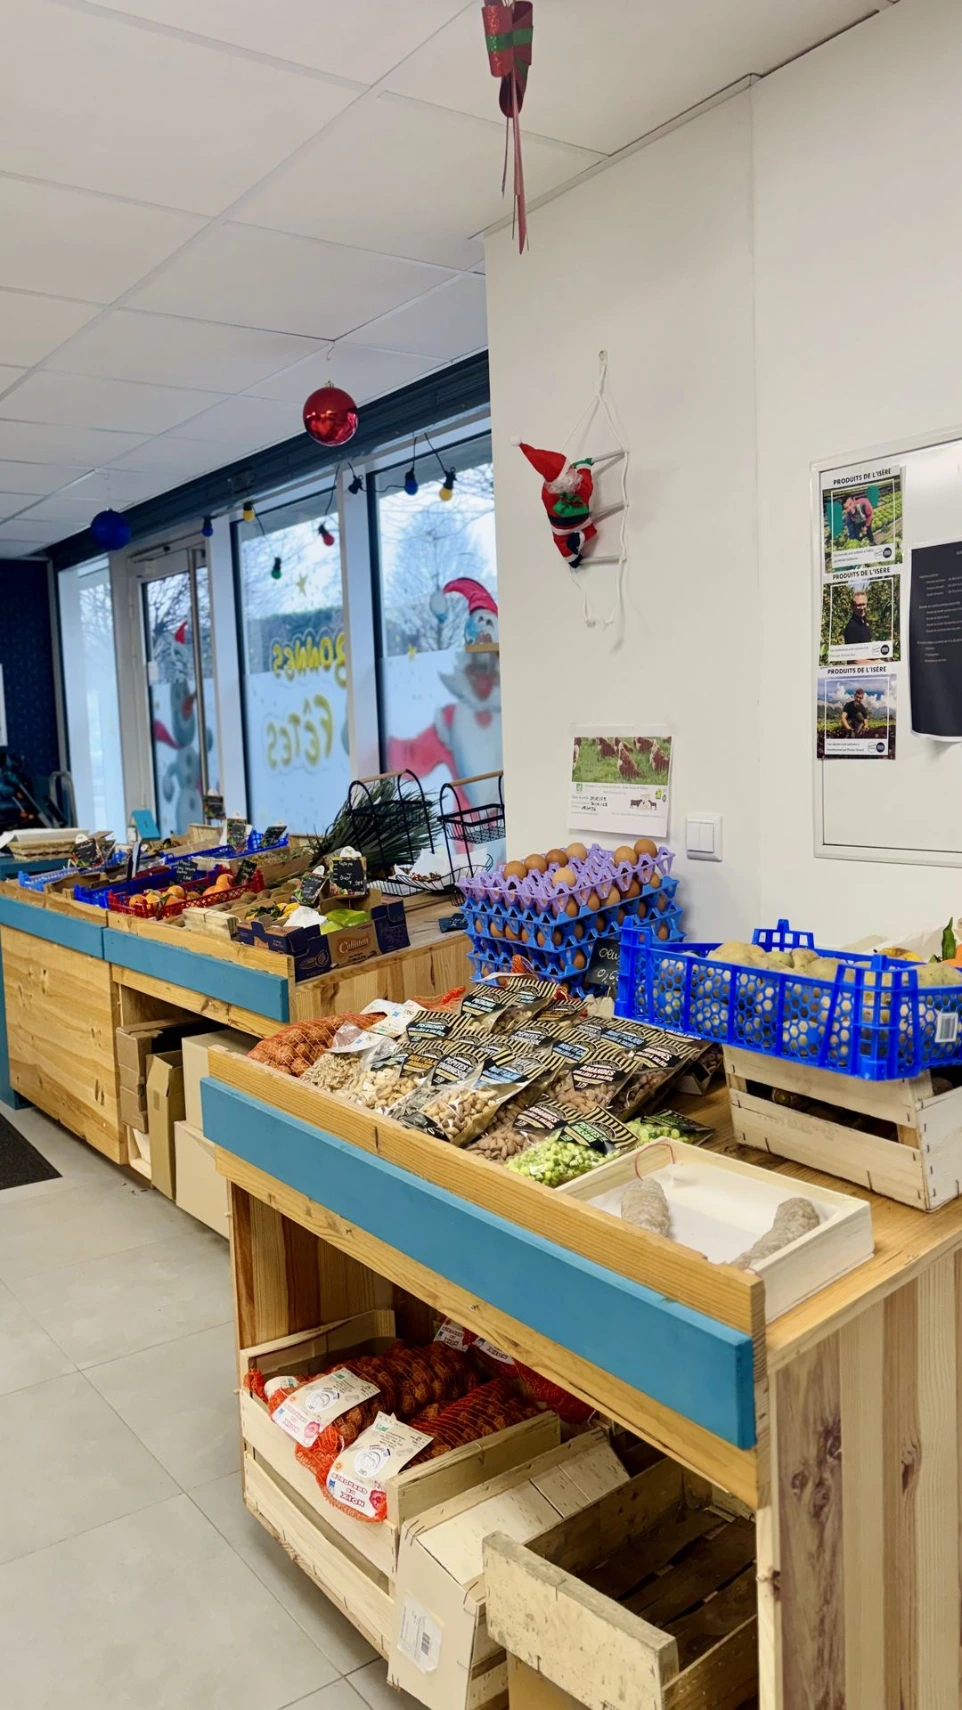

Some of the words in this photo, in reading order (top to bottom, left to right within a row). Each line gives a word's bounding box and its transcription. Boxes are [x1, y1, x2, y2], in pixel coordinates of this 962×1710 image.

[833, 474, 862, 486] PRODUITS
[863, 472, 871, 480] DE
[832, 571, 860, 580] PRODUITS
[827, 667, 856, 675] PRODUITS
[866, 665, 887, 673] L'ISÈRE
